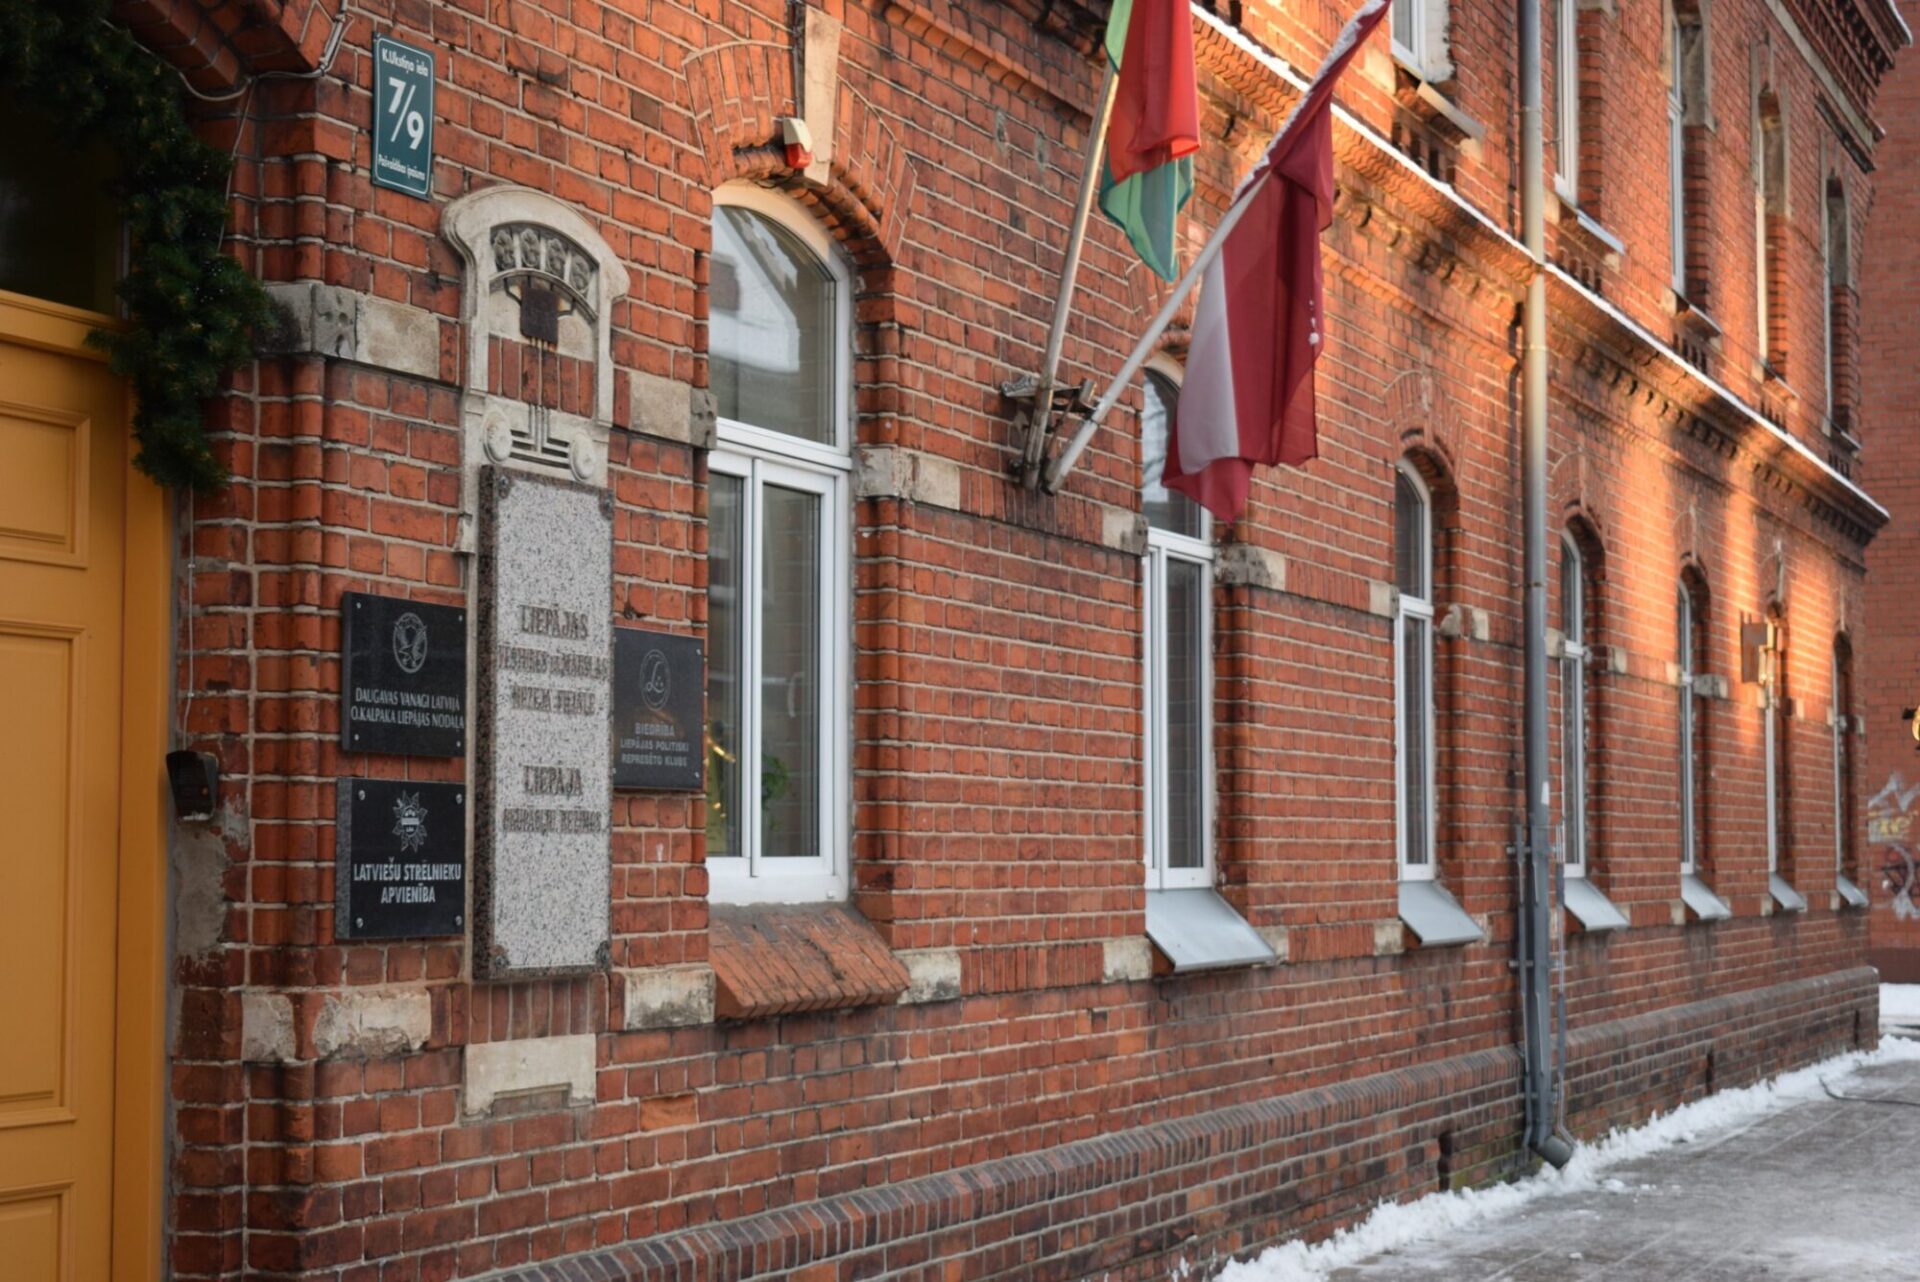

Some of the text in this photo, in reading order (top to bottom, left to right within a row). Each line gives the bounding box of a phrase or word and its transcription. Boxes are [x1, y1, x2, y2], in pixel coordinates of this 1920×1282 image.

[416, 59, 428, 76] iela
[388, 76, 424, 150] 7/9
[519, 603, 589, 640] LIEPĀJAS
[356, 687, 460, 711] DAUGAVAS VANAGI LATVIJĀ
[351, 706, 395, 723] O.KALPAKA
[398, 709, 430, 728] LIEPĀJAS
[522, 761, 583, 797] LIEPĀJA
[354, 857, 462, 881] LATVIEŠU STRĒLNIEKU
[381, 882, 436, 904] APVIENĪBA
